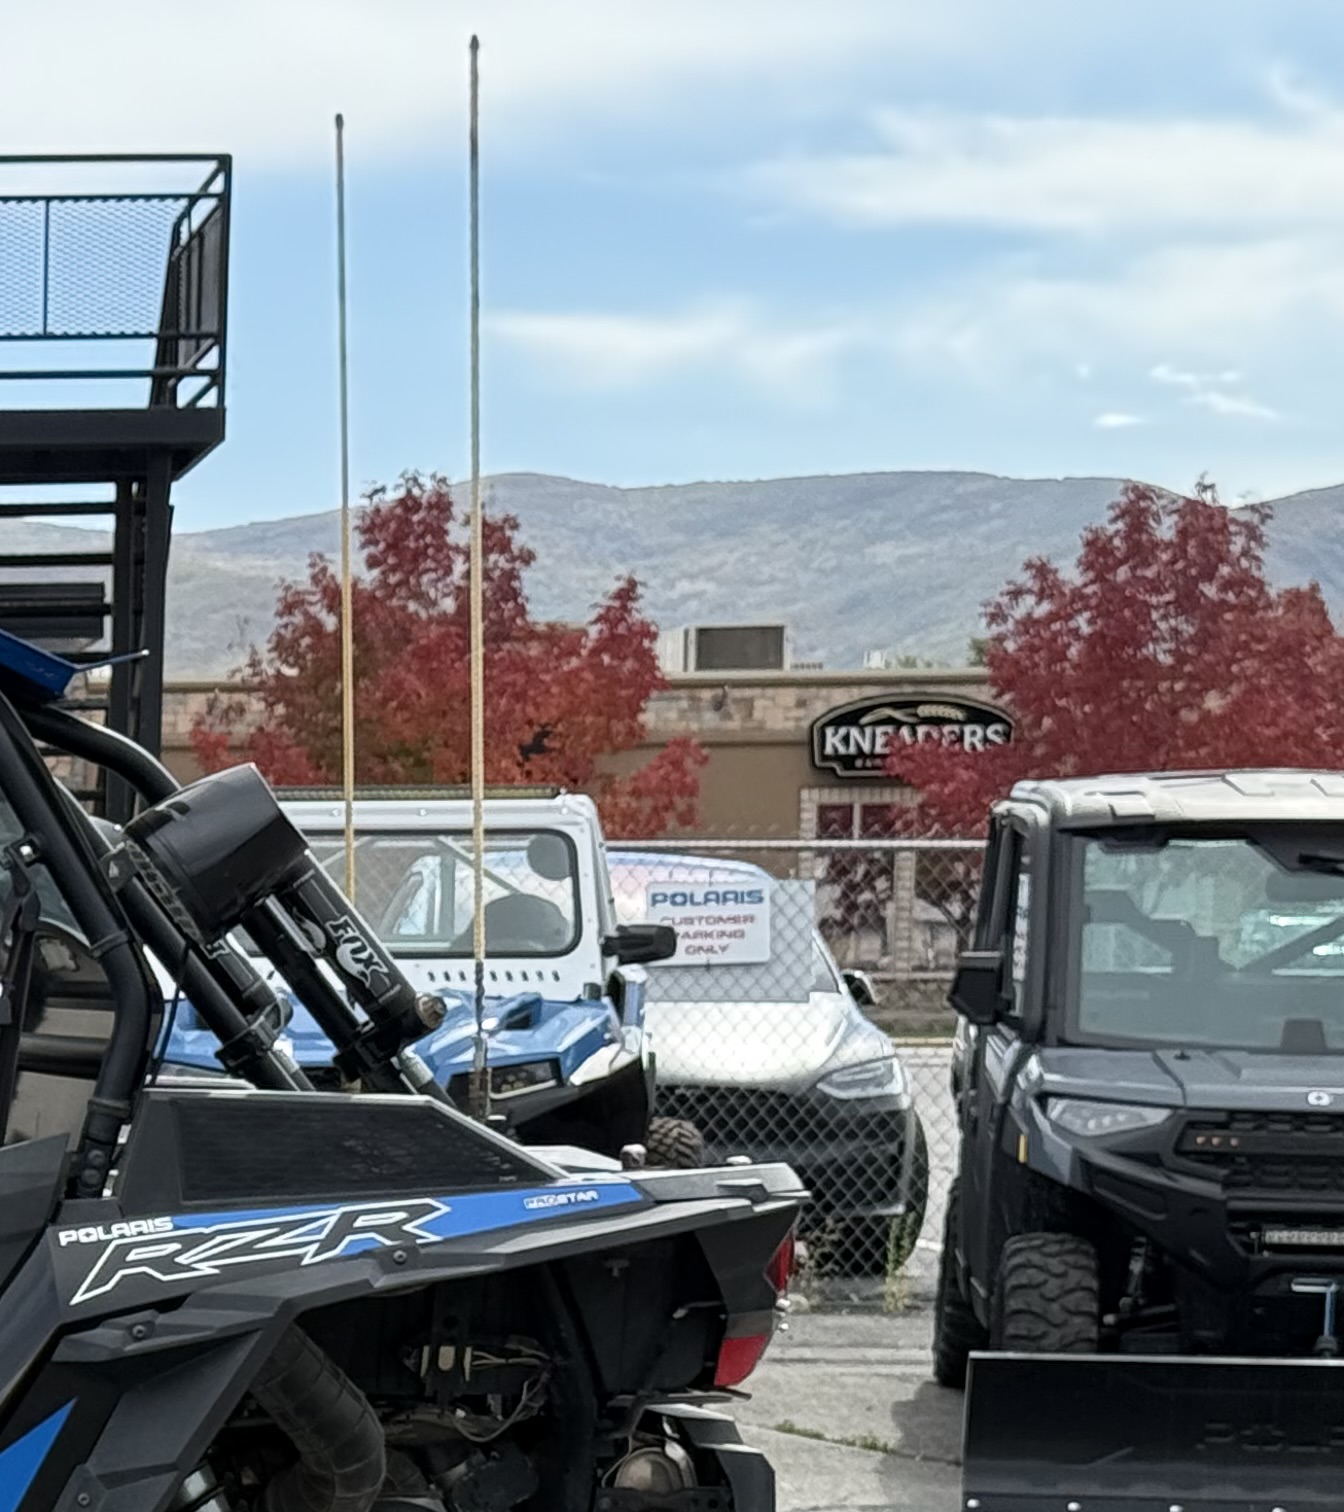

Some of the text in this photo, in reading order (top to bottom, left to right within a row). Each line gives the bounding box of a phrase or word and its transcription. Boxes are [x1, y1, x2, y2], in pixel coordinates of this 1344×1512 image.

[651, 889, 765, 907] POLARIS
[324, 915, 390, 973] FOX
[676, 929, 745, 940] ARKING
[685, 944, 730, 956] ONLY
[523, 1190, 599, 1210] PROSTAR
[59, 1216, 173, 1247] POLARIS
[70, 1198, 451, 1305] RZR
